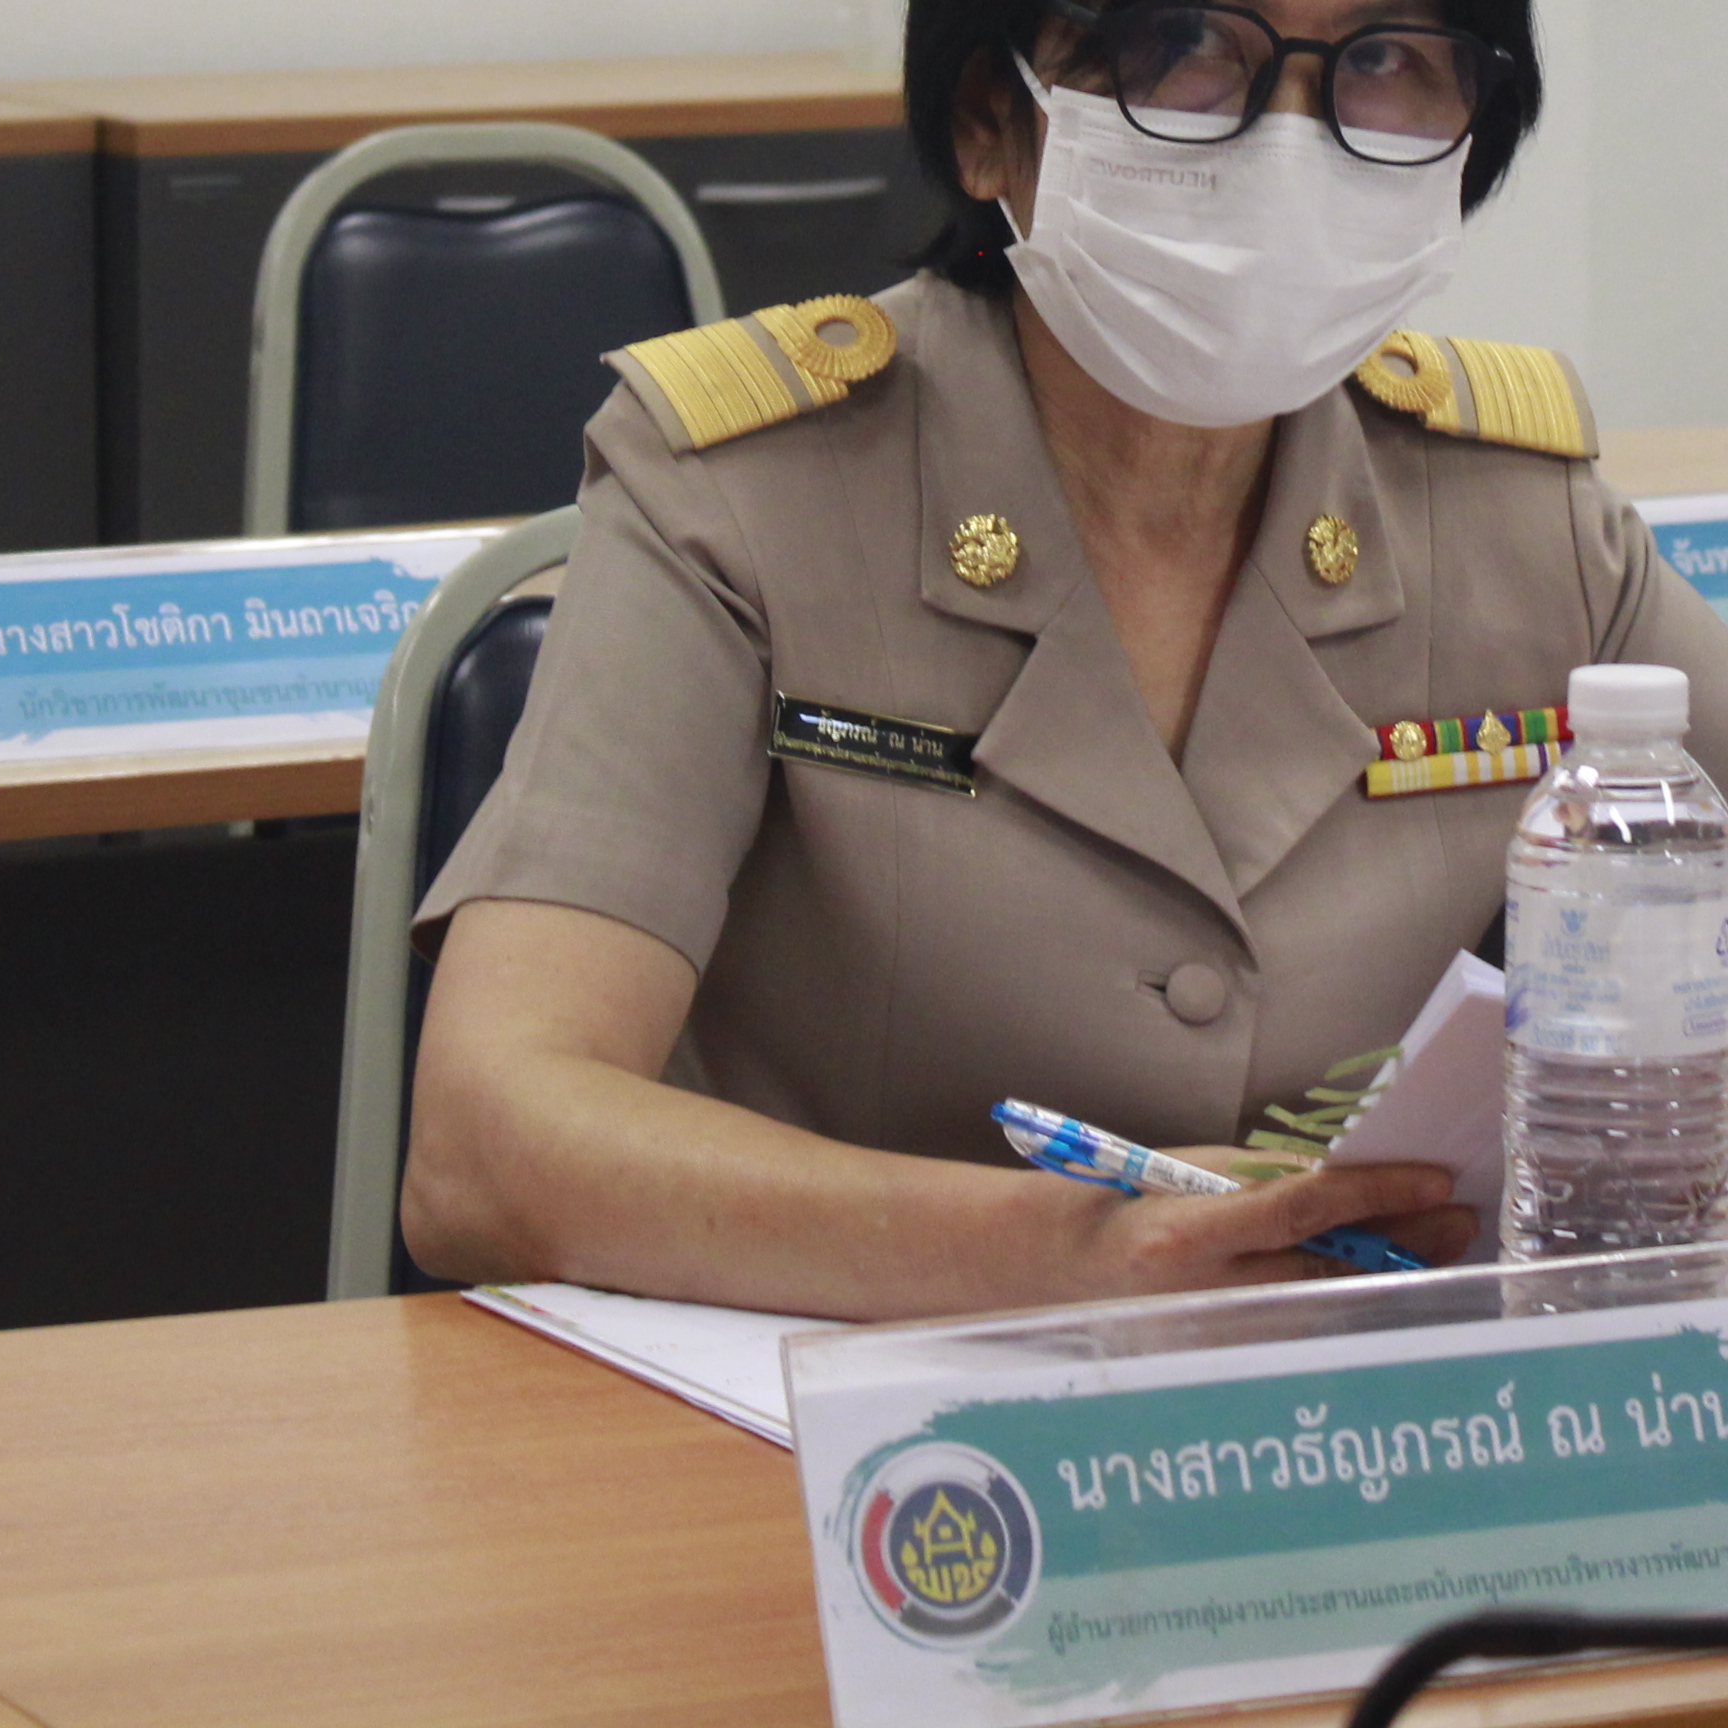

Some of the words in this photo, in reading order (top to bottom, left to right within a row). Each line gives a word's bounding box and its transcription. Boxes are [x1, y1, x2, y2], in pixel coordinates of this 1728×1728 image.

[1057, 1380, 1525, 1511] นางสาวธัญภรณ์
[1546, 1401, 1606, 1459] ณ
